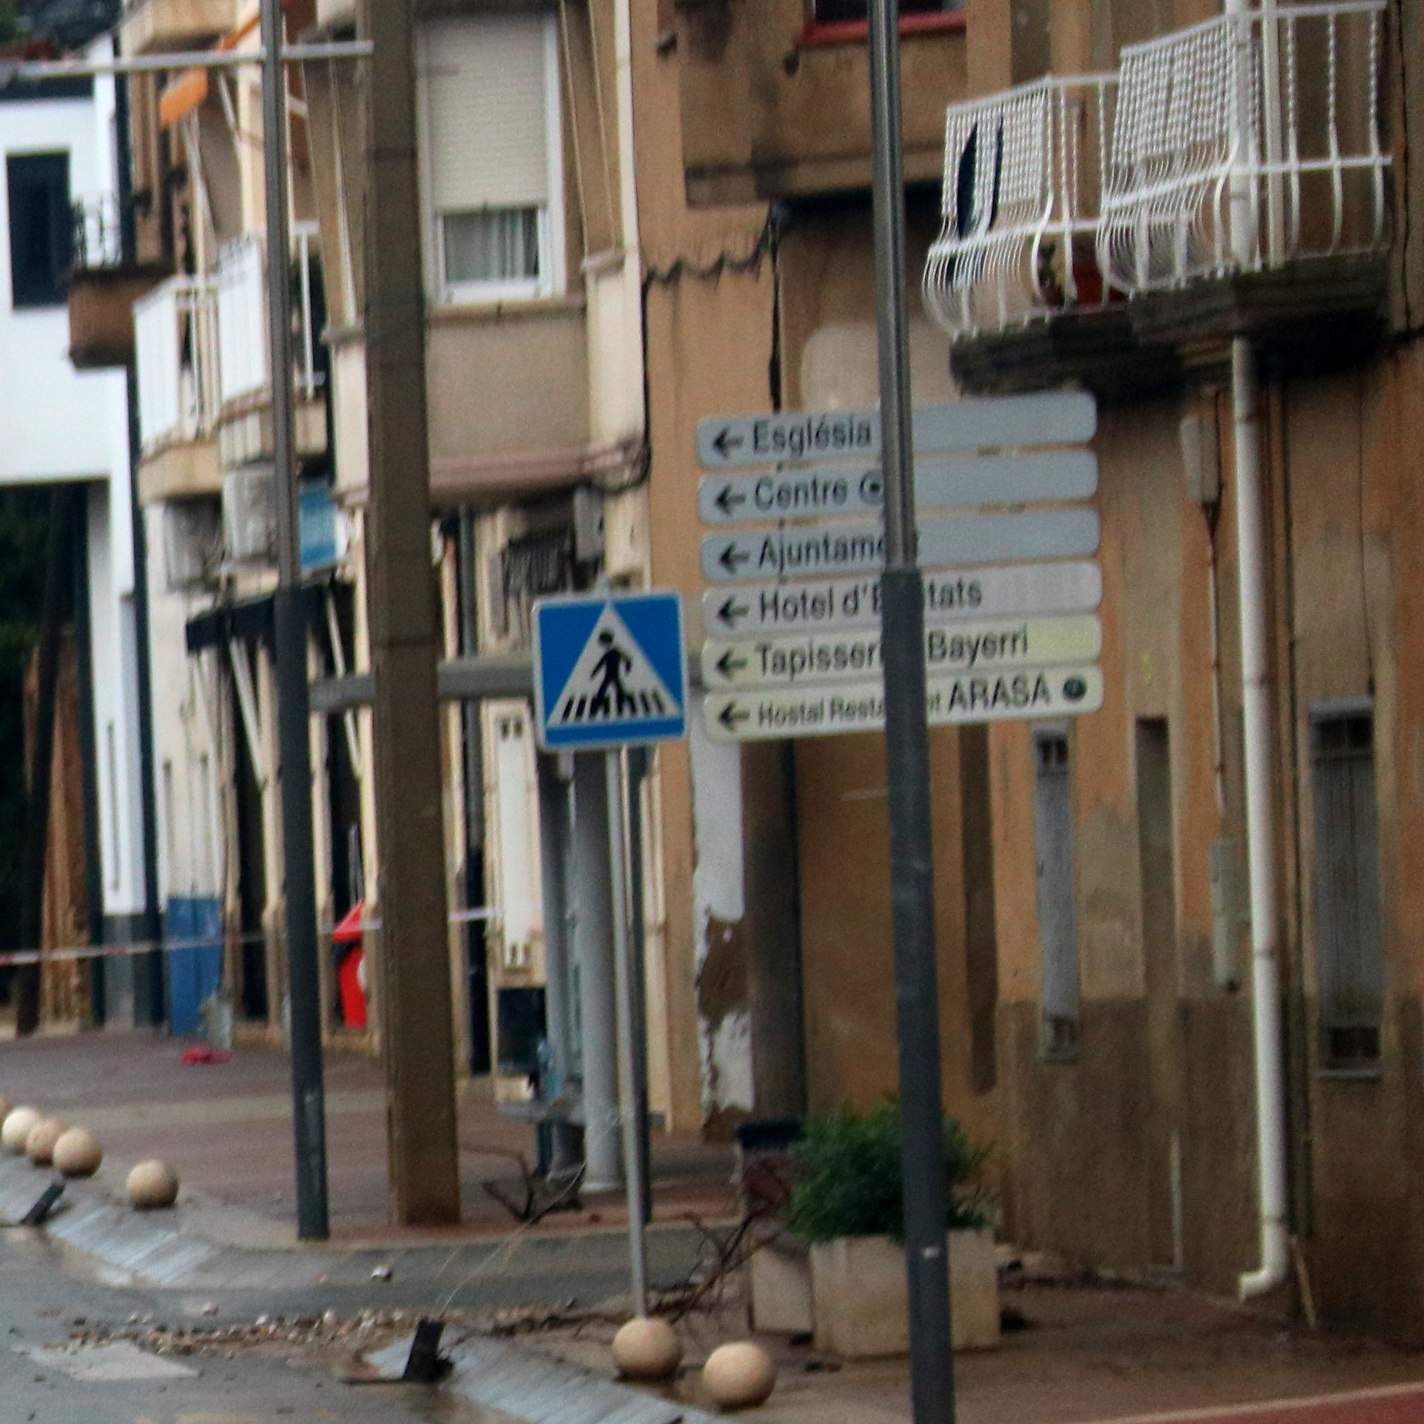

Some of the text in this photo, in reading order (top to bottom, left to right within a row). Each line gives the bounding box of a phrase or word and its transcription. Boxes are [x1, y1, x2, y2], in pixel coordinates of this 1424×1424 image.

[753, 413, 872, 461] Església
[754, 474, 849, 512] Centre
[758, 584, 835, 622] Hotel
[928, 621, 1029, 669] Bayerri
[758, 697, 825, 728] Hostal
[948, 671, 1051, 712] ARASA
